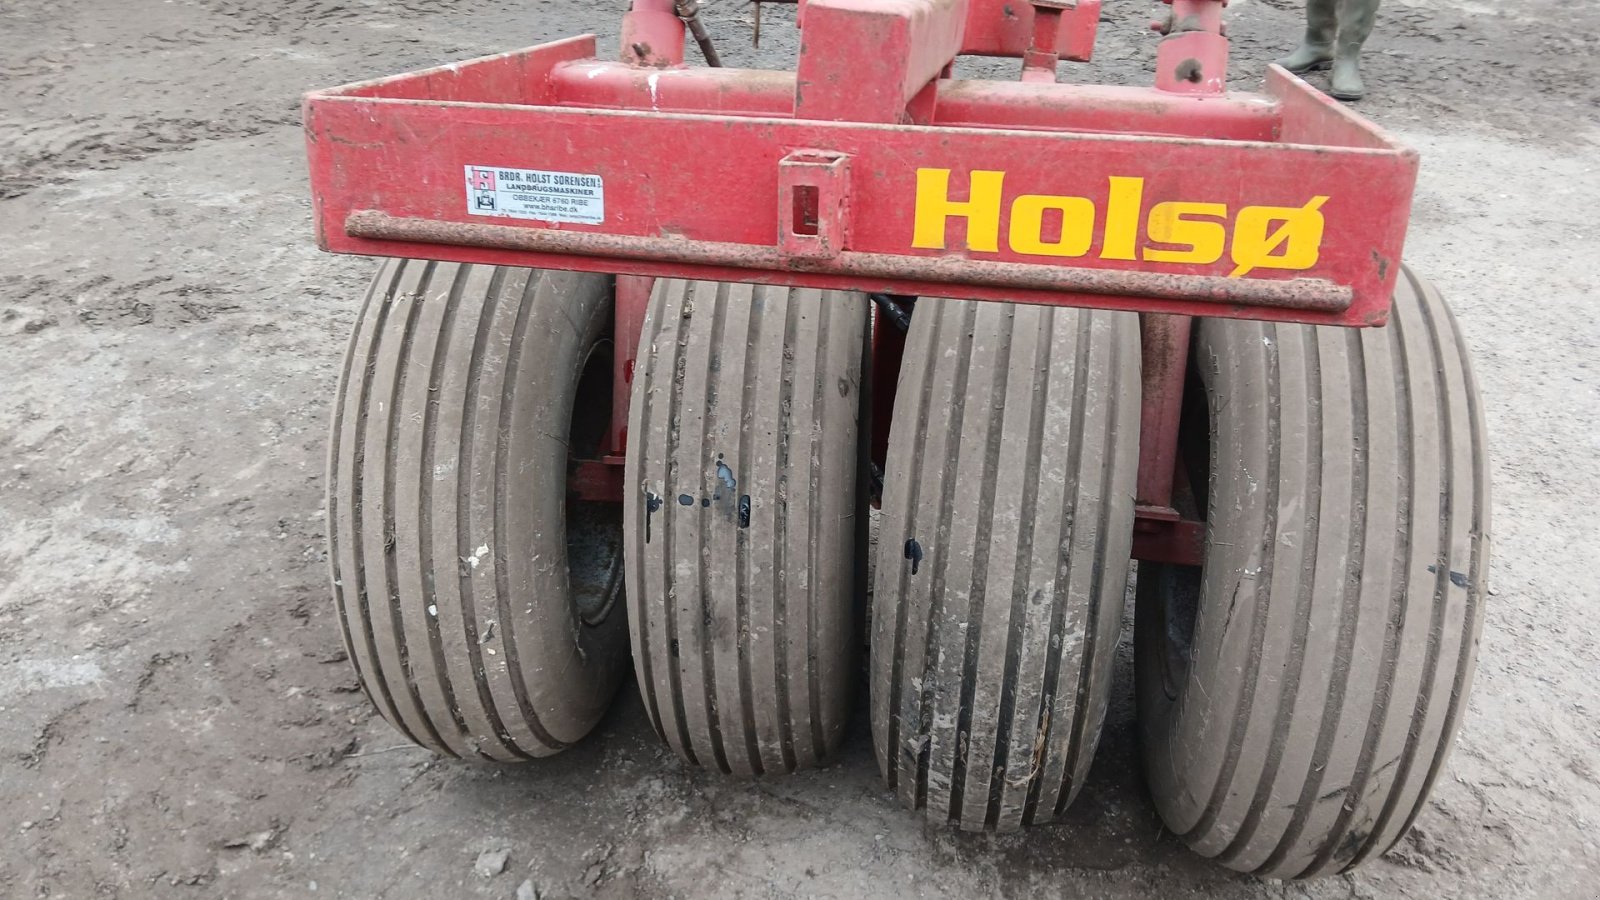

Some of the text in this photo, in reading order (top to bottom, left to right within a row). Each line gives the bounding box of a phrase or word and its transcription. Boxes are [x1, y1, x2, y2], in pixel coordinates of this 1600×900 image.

[499, 171, 523, 182] BRDR.
[526, 172, 551, 184] HOLST
[506, 183, 594, 196] LANDBRUGSMASKINER
[570, 198, 589, 206] RIBE
[911, 168, 1330, 277] Holsø
